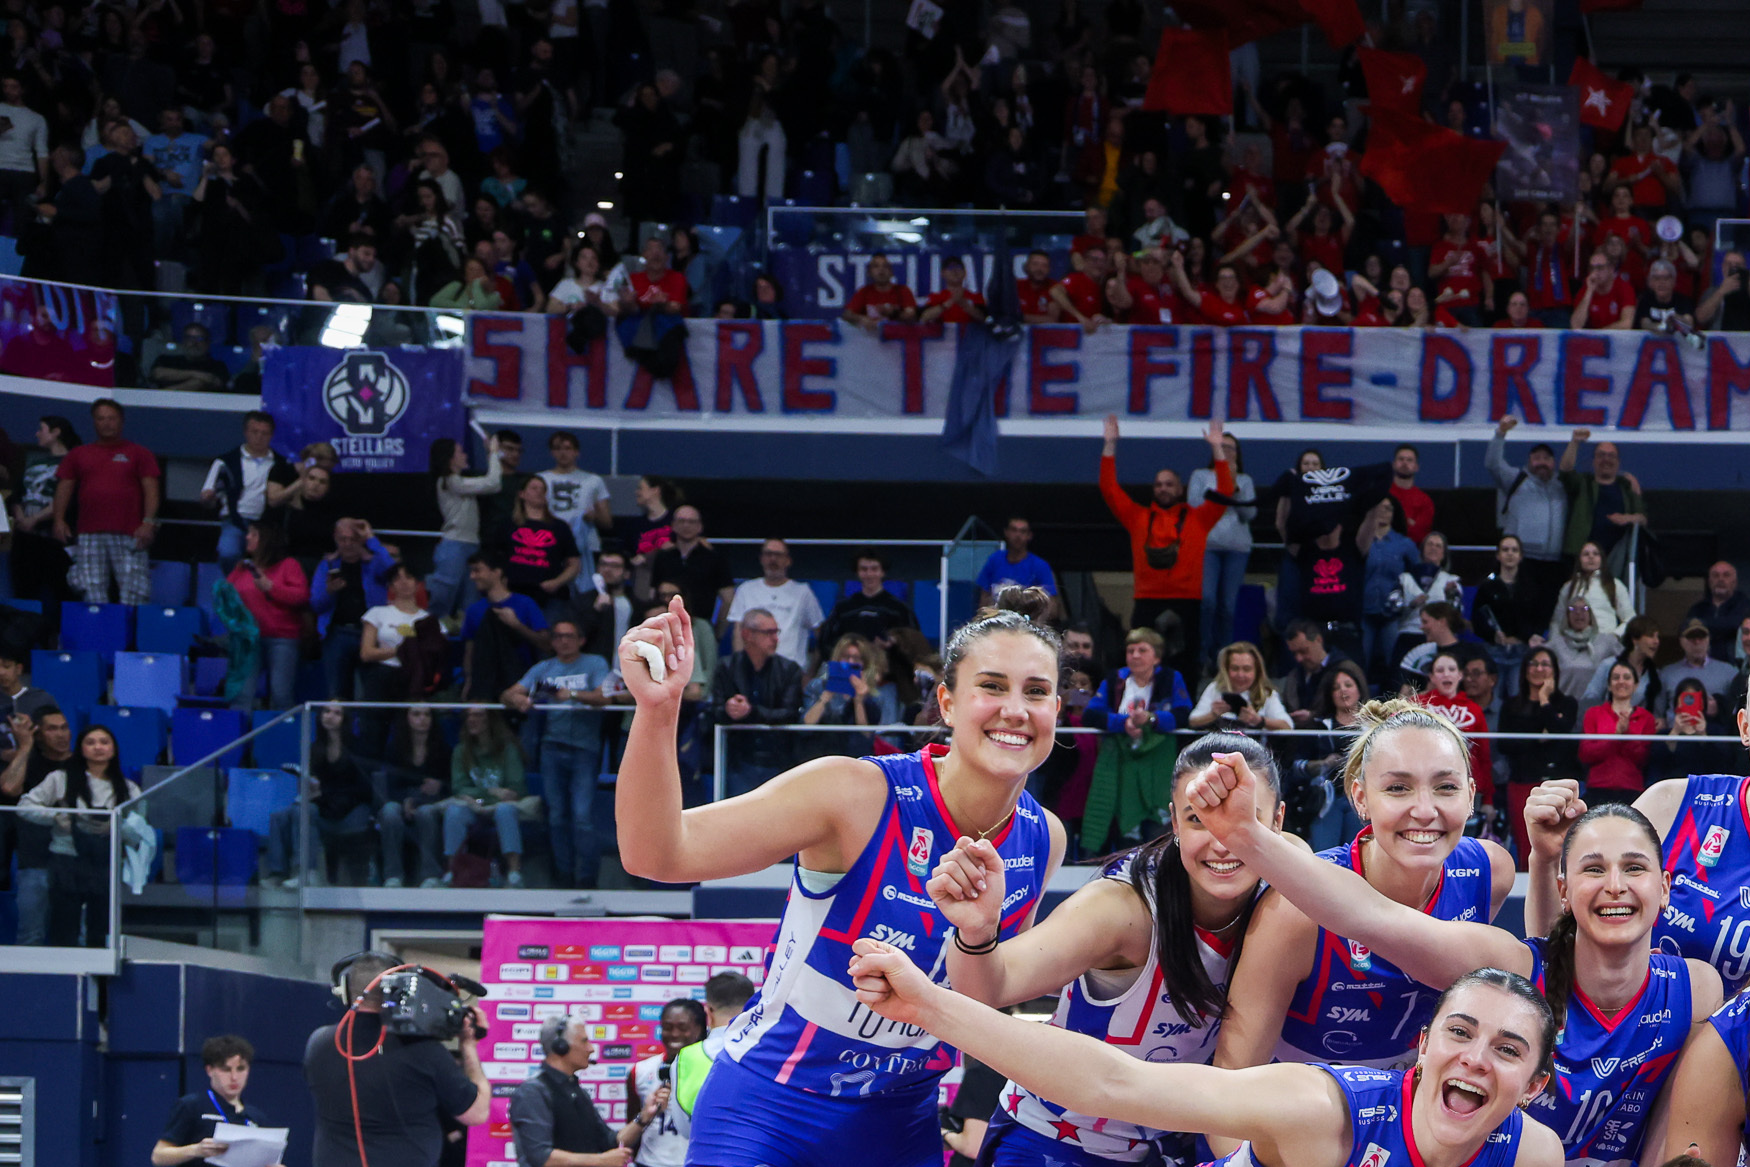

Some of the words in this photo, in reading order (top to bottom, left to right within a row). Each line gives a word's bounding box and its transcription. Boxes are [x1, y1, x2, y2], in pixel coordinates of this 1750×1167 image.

[879, 322, 1080, 416] TE
[330, 437, 405, 457] STELLARS
[1446, 867, 1480, 878] KGM
[1000, 884, 1030, 912] REDDY
[1662, 904, 1697, 933] SYM
[868, 923, 917, 951] SYM
[1326, 1005, 1372, 1023] SYM
[1152, 1021, 1193, 1036] SYM
